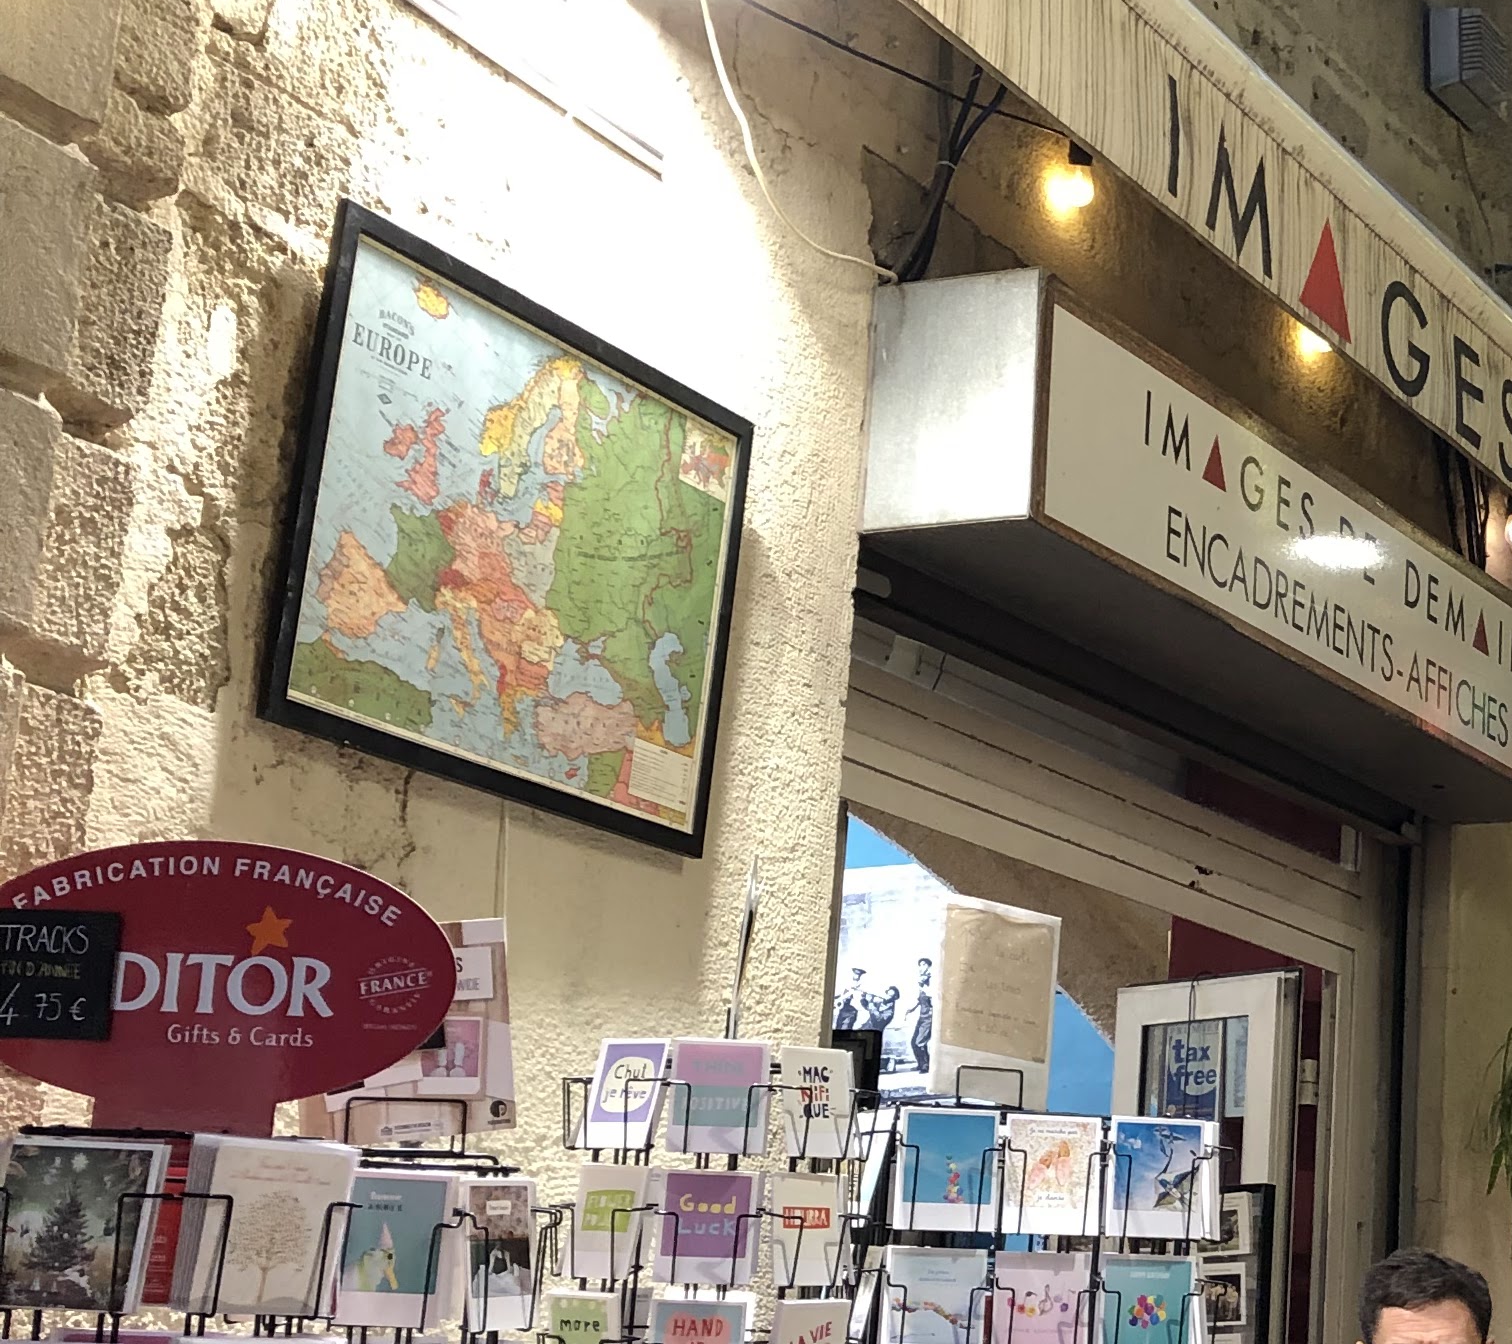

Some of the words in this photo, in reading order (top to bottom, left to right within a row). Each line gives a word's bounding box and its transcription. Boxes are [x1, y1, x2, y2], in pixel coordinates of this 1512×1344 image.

[352, 322, 433, 380] EUROPE
[12, 855, 220, 910] FABRICATION
[234, 857, 402, 928] FRANÇAISE
[112, 951, 334, 1018] DITOR
[360, 971, 428, 996] FRANCE
[167, 1024, 220, 1045] Gifts
[228, 1026, 241, 1045] &
[249, 1025, 314, 1048] Cards
[1172, 1038, 1211, 1064] tax
[1174, 1064, 1217, 1091] free
[680, 1193, 737, 1215] Good
[672, 1318, 724, 1338] HAND
[809, 1321, 832, 1344] VIE
